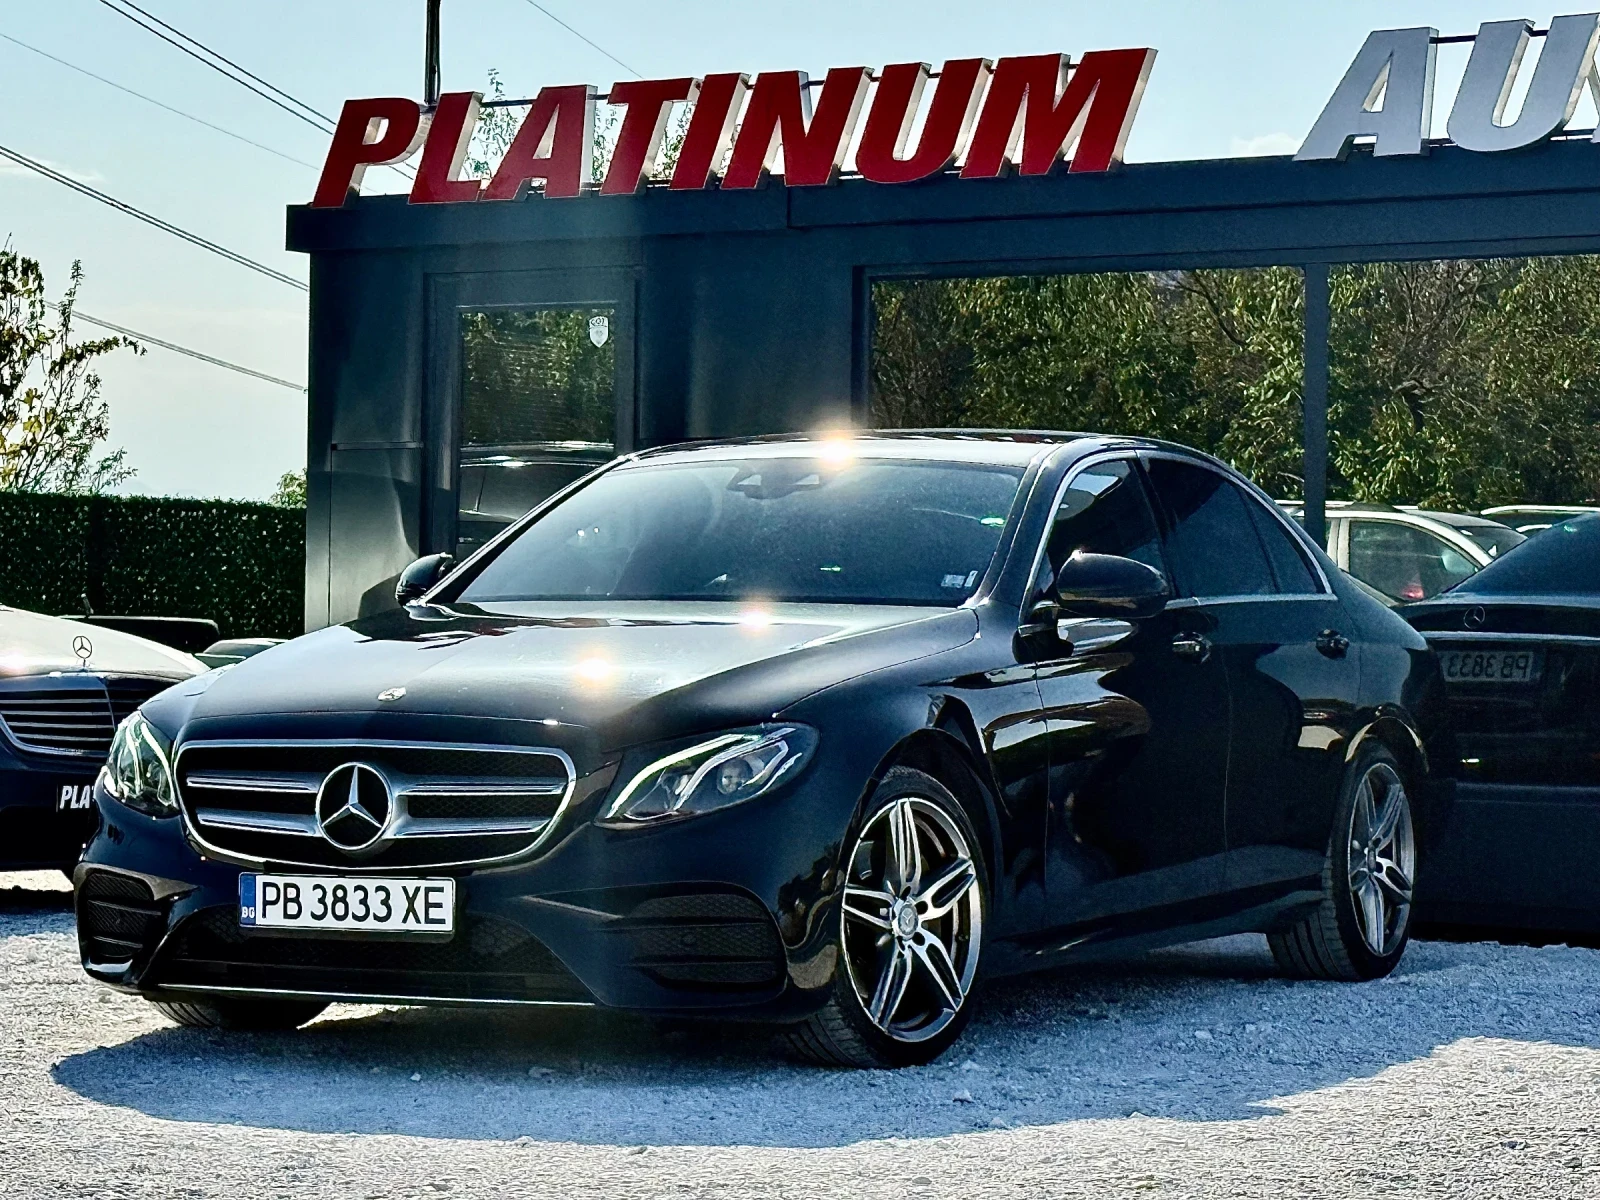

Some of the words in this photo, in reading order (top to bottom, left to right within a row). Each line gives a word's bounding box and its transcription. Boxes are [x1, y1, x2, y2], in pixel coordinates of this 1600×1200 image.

[312, 48, 1158, 209] PLATINUM
[1293, 12, 1600, 162] AU
[59, 785, 96, 810] PLA
[241, 906, 256, 919] BG
[261, 881, 303, 920] PB
[310, 883, 393, 923] 3833
[401, 886, 447, 925] XE
